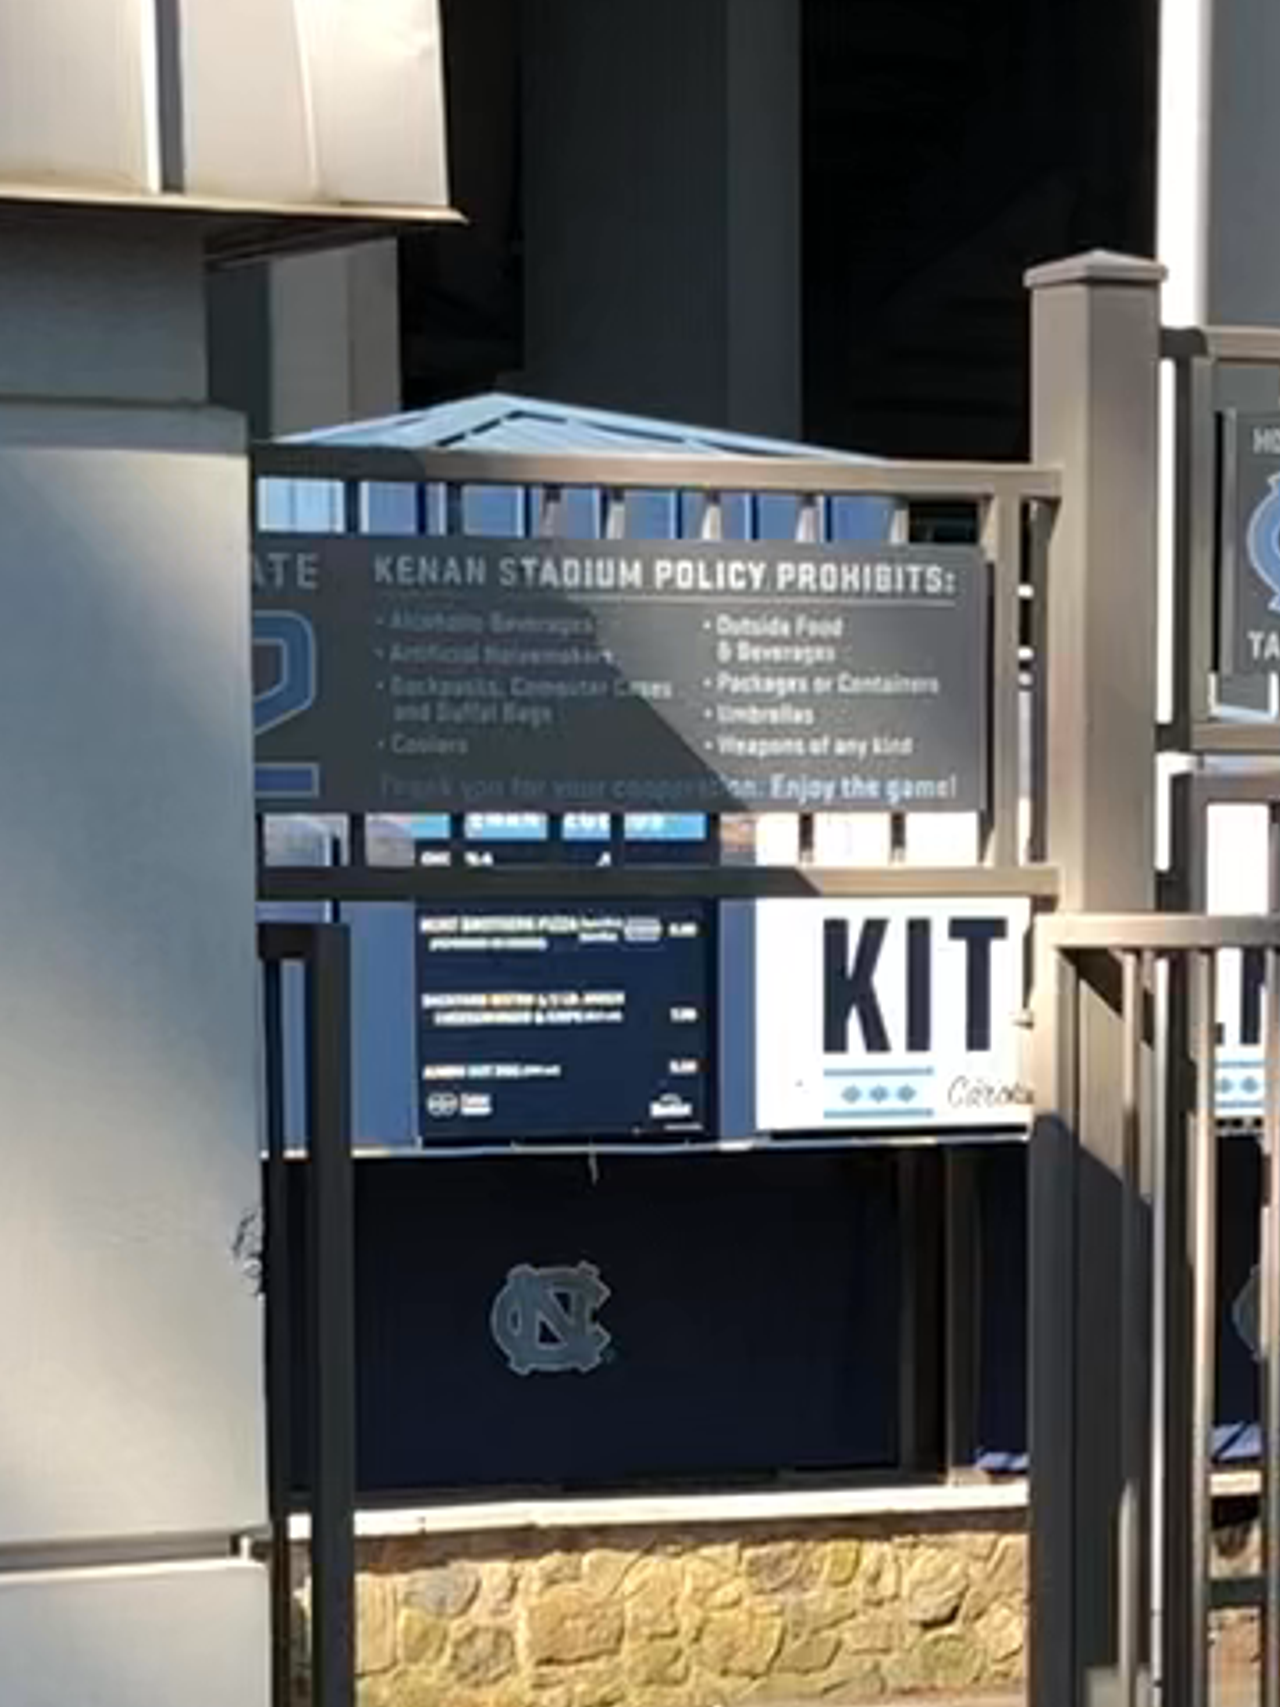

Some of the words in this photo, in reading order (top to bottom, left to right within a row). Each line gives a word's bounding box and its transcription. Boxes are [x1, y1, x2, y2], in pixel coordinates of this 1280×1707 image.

[374, 555, 486, 584] KENAN
[499, 556, 642, 589] STADIUM
[655, 559, 767, 590] POLICY
[777, 561, 956, 593] PROHIBITS:
[716, 614, 790, 637] Outside
[795, 616, 843, 637] Food
[737, 641, 835, 665] Beverages
[716, 672, 808, 697] Packages
[812, 677, 833, 693] or
[837, 671, 940, 694] Containers
[716, 704, 814, 725] Umbrellas
[716, 736, 806, 758] Weapons
[809, 736, 829, 755] of
[834, 739, 867, 760] any
[873, 736, 913, 754] kind
[771, 773, 834, 804] Enjoy
[840, 773, 880, 799] the
[884, 773, 957, 804] game!
